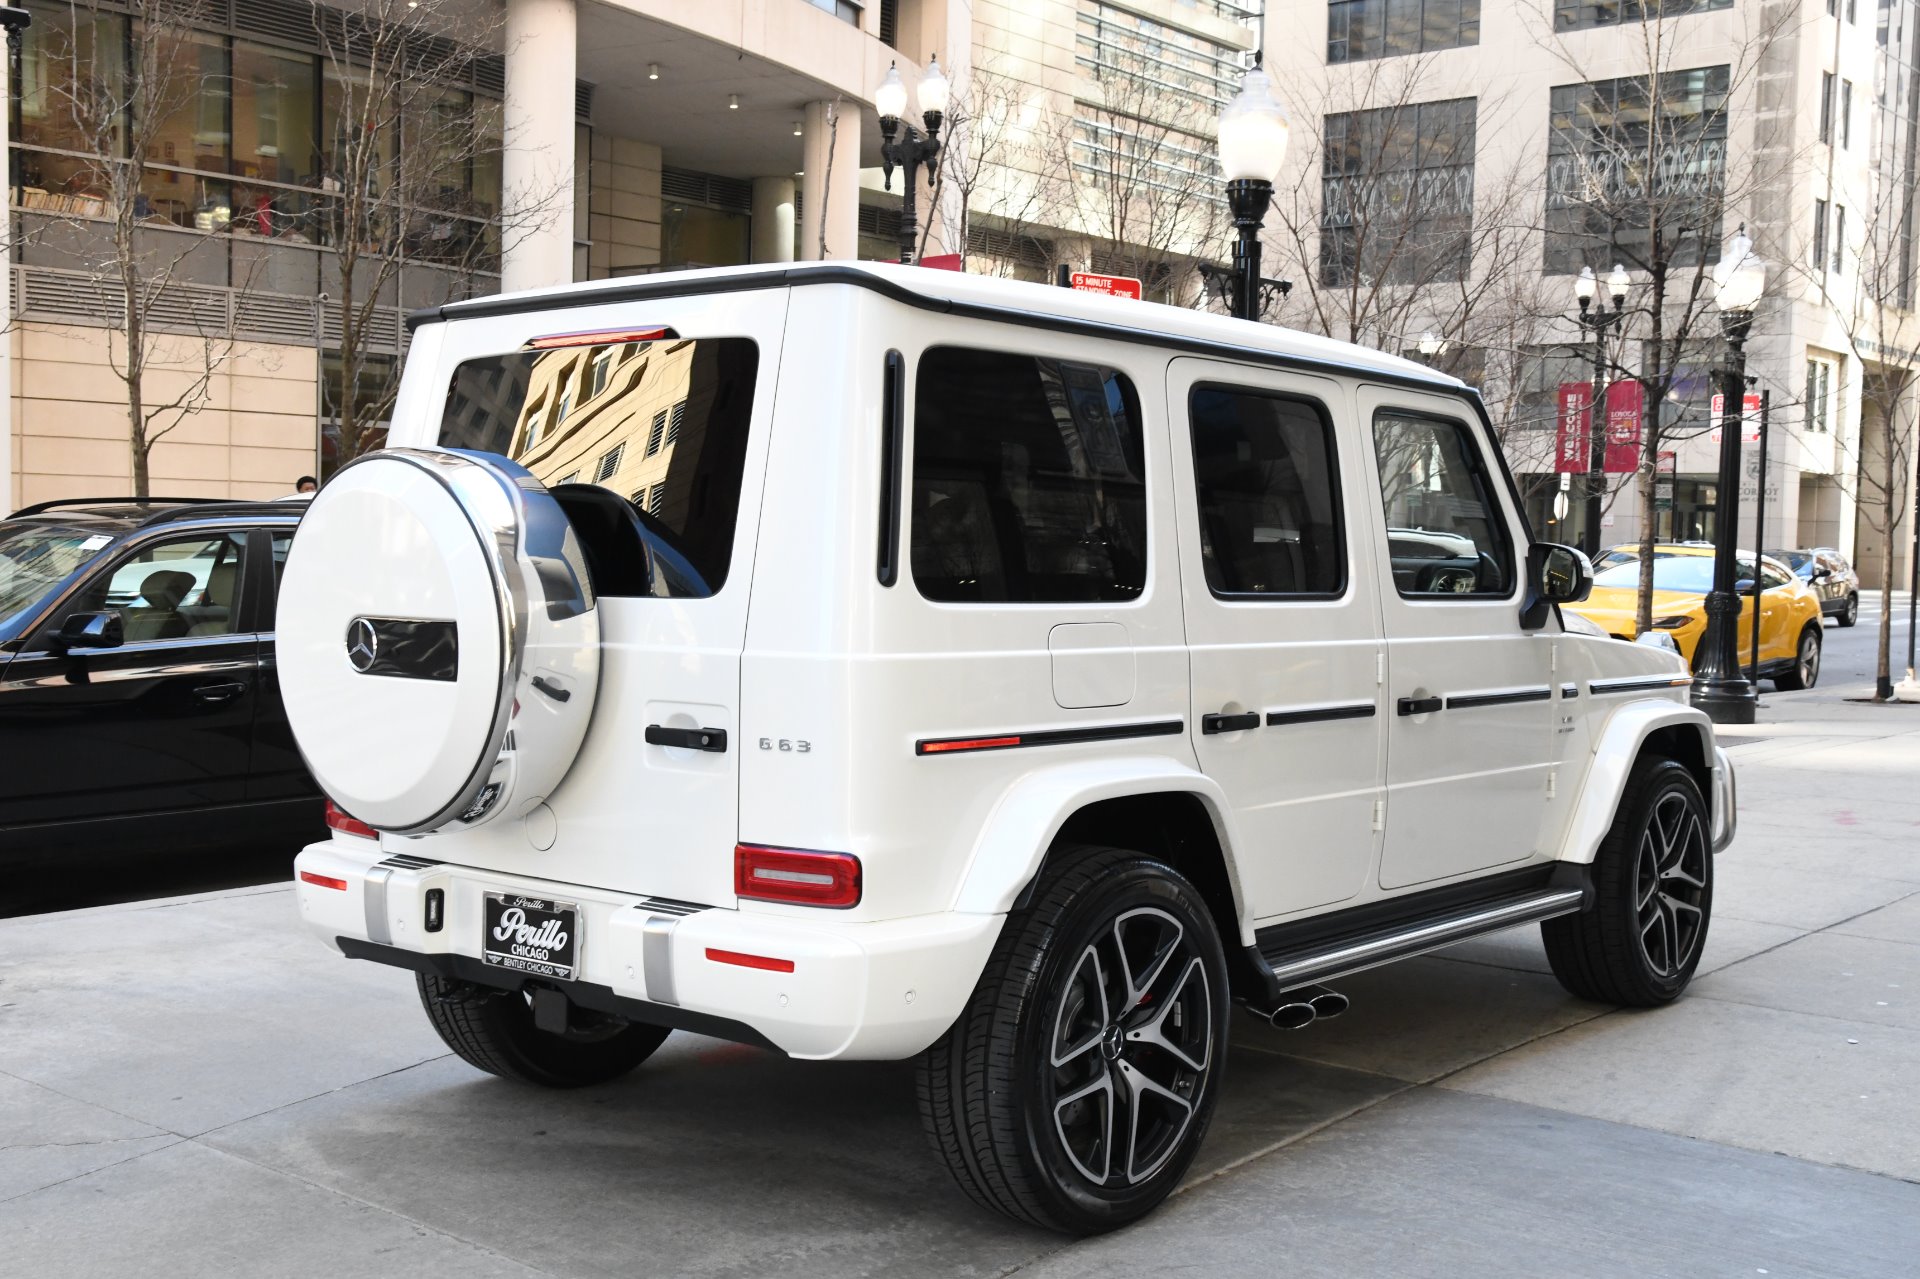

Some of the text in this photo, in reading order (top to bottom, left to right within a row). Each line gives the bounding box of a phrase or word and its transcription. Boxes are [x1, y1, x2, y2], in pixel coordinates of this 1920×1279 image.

[1076, 276, 1112, 288] 15 MINUTE
[1739, 487, 1779, 496] COROY
[513, 896, 545, 909] Perillo
[493, 908, 568, 951] Perillo
[511, 944, 549, 961] CHICAGO
[503, 957, 553, 975] BENTLEY CHICAGO
